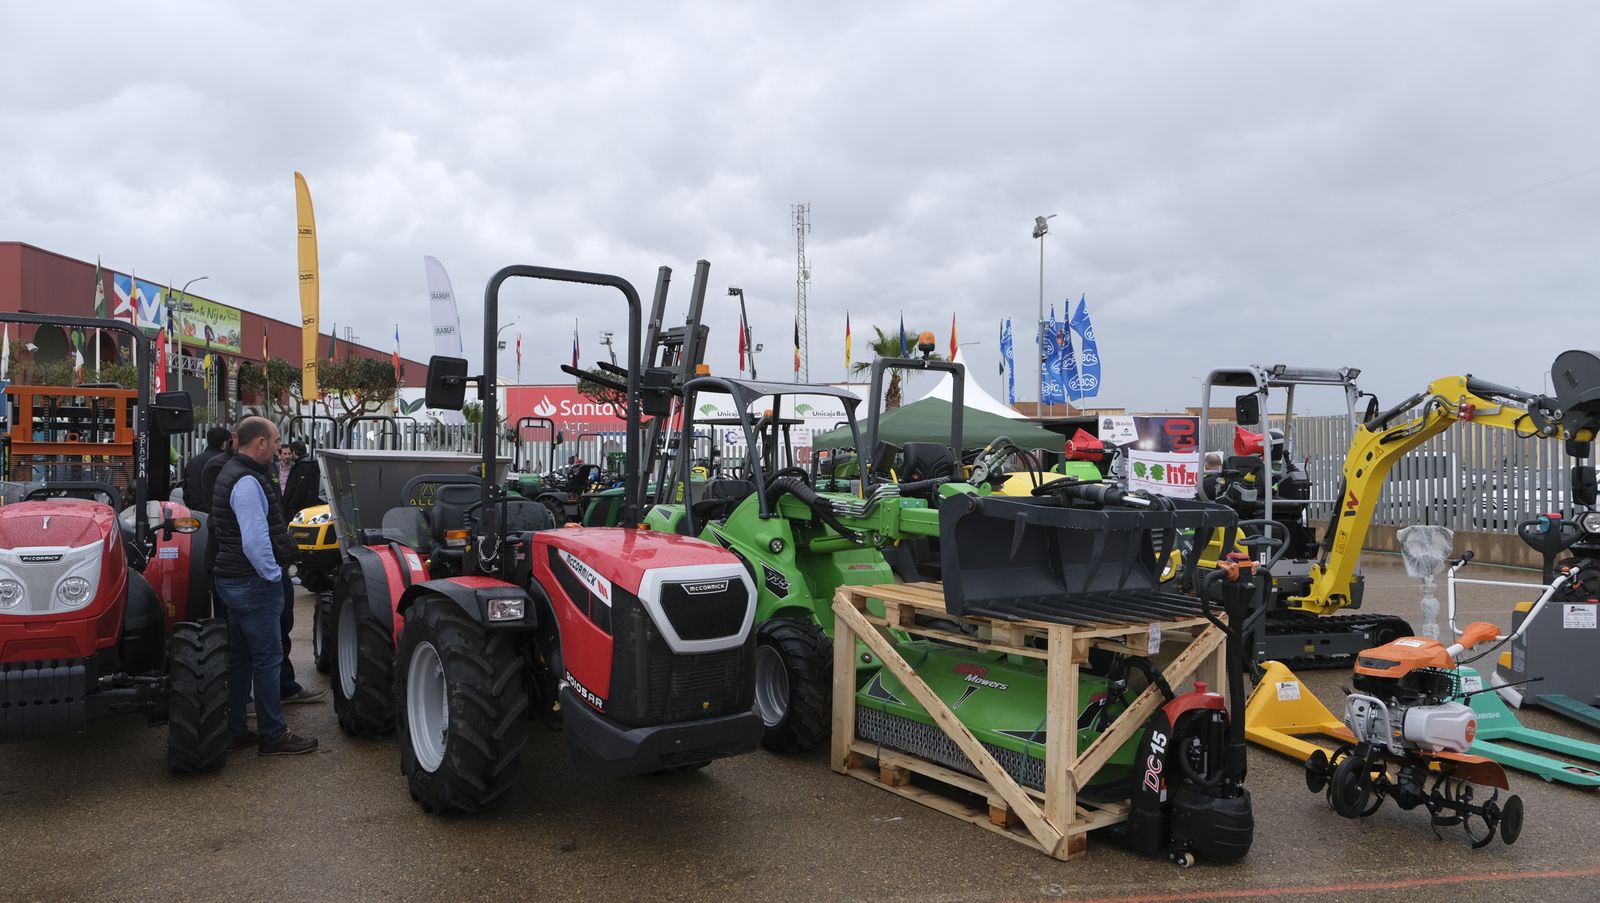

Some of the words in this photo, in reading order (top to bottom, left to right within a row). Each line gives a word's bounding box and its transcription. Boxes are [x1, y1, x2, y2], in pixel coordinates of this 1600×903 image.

[812, 410, 835, 418] Unicaja
[139, 431, 147, 478] SPAGNA
[964, 673, 1009, 690] Mowers
